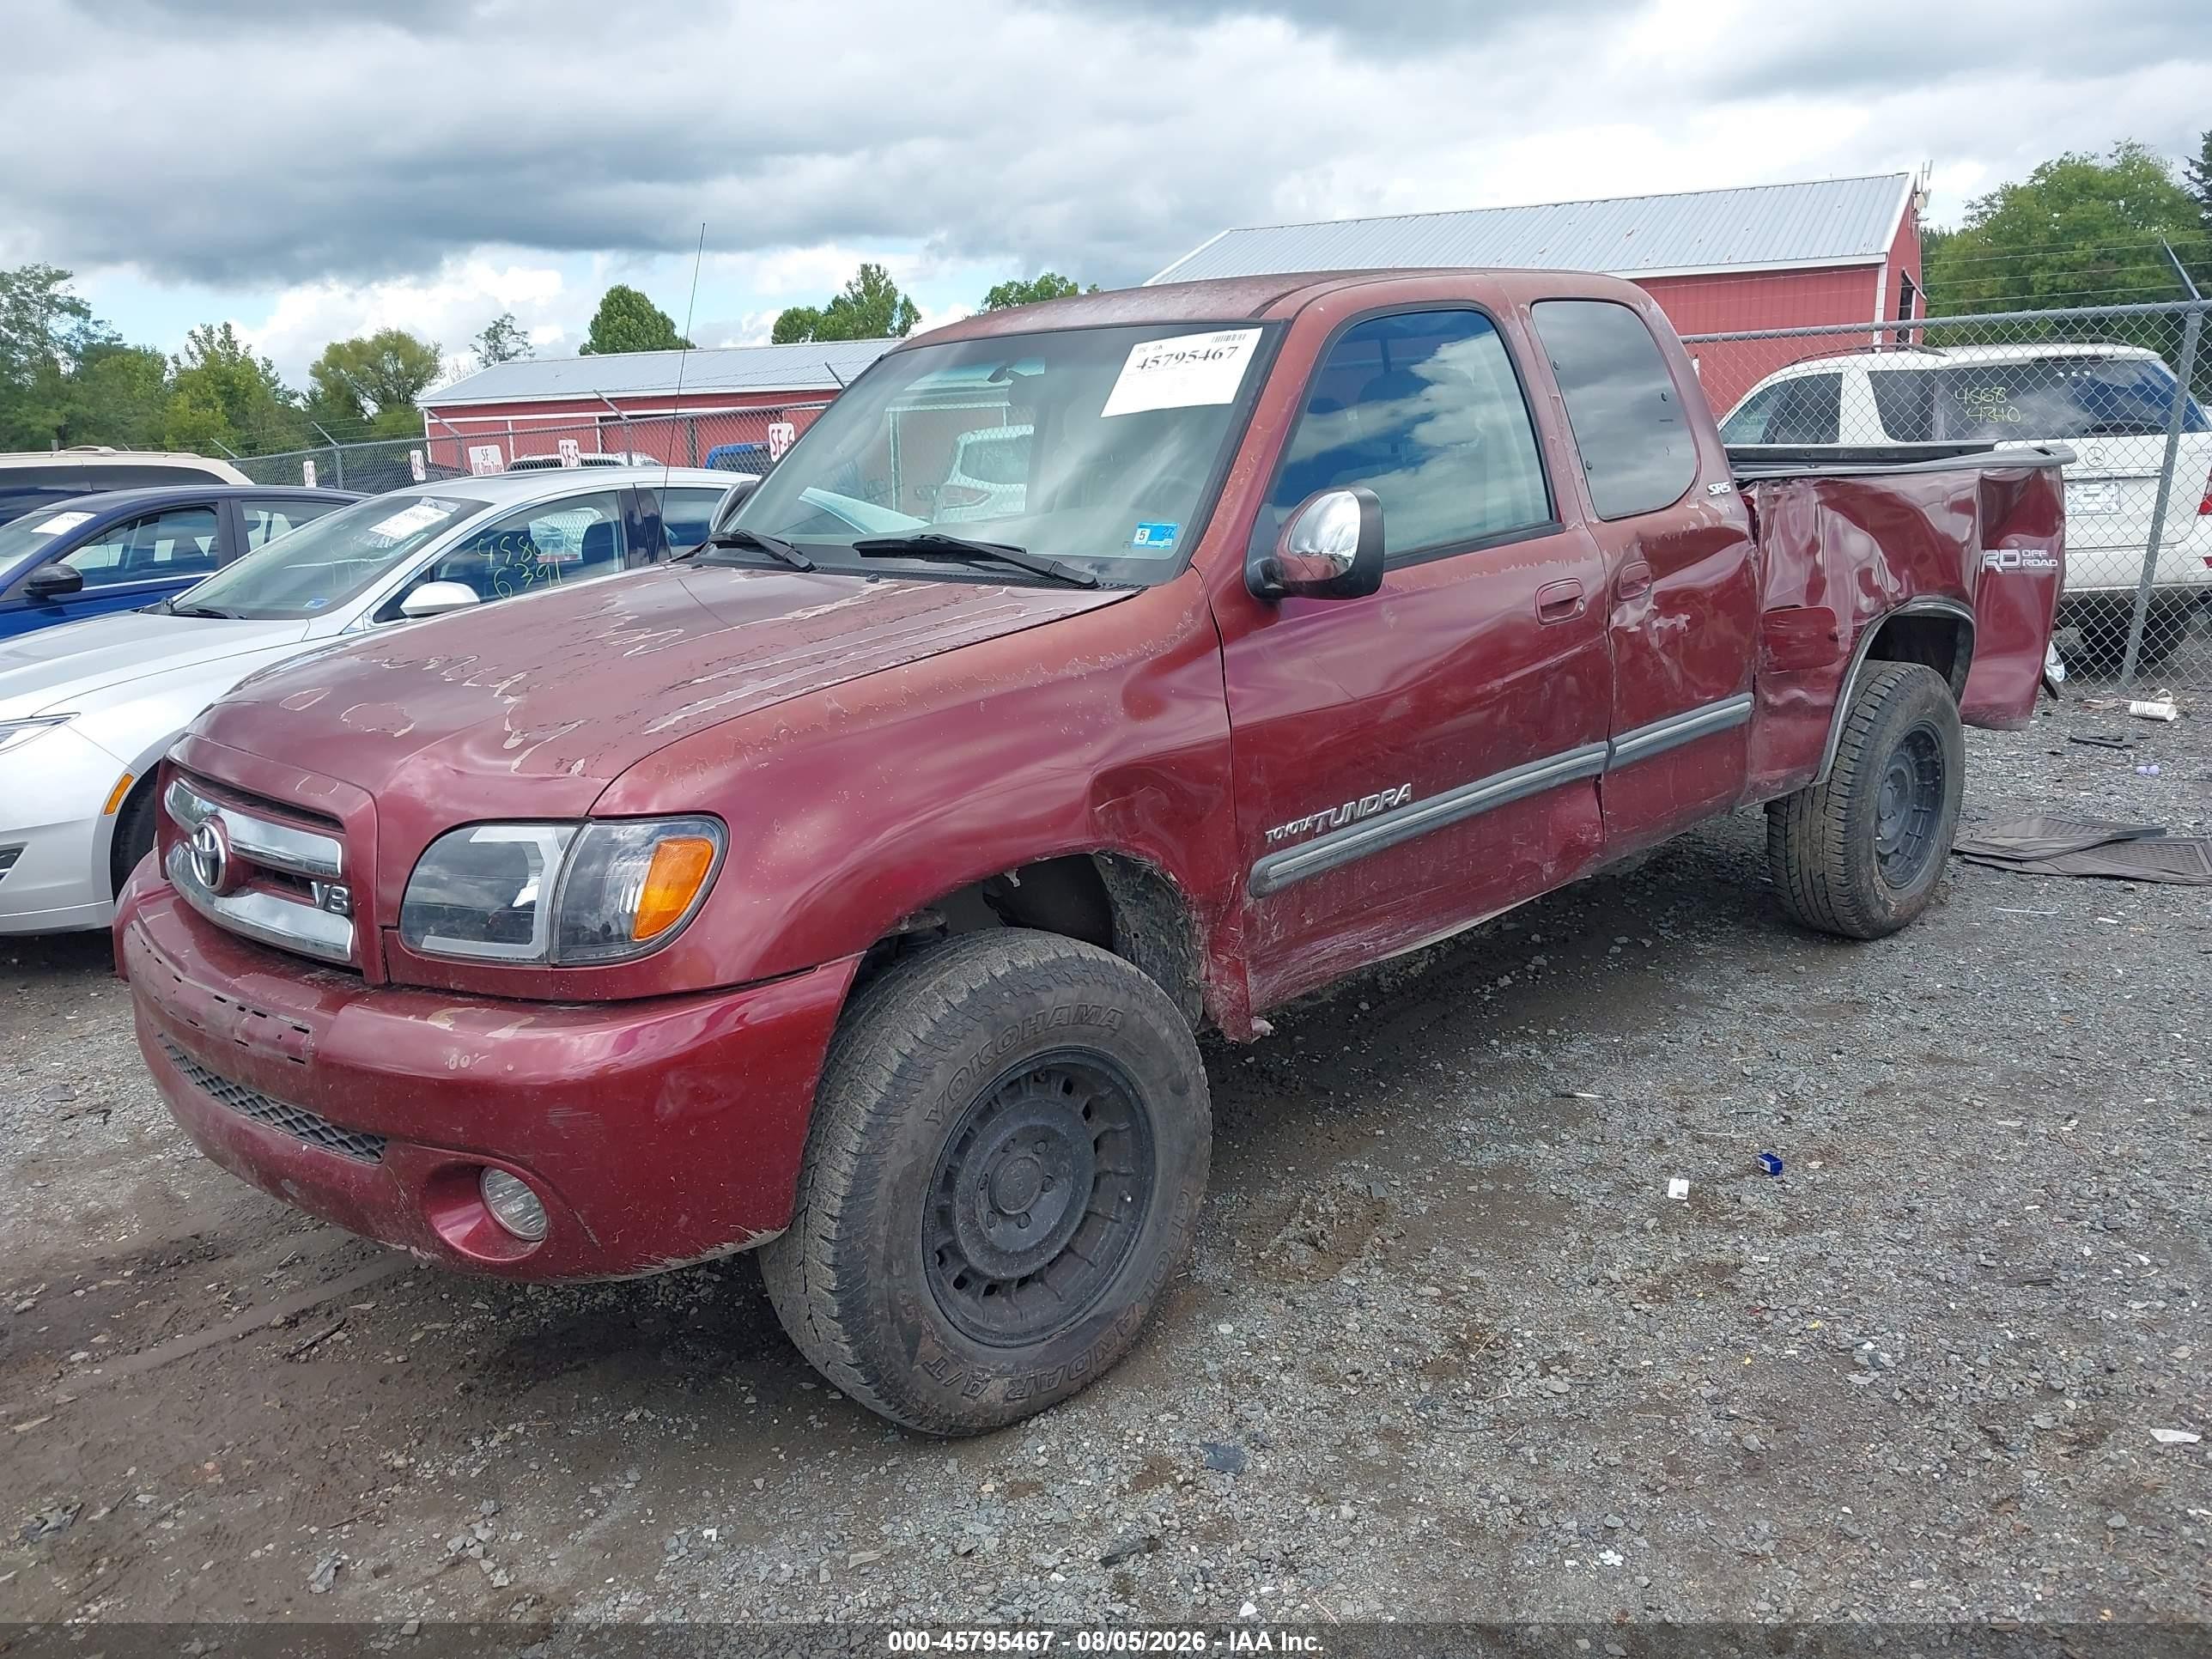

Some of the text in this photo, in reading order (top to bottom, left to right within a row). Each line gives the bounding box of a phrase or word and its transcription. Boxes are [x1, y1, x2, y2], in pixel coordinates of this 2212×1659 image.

[1137, 346, 1238, 370] 45795467
[1954, 386, 2007, 404] 4568
[1966, 405, 2021, 423] 4340
[1708, 481, 1731, 495] SR5
[1139, 530, 1146, 540] 5
[1162, 527, 1175, 537] 27
[1981, 550, 2020, 574] RD
[494, 559, 562, 599] 6391
[1265, 782, 1412, 843] TOYOTA TUNDRA
[310, 881, 349, 914] V8
[924, 1002, 1125, 1126] YOKOHAMA
[921, 1354, 993, 1401] A/T
